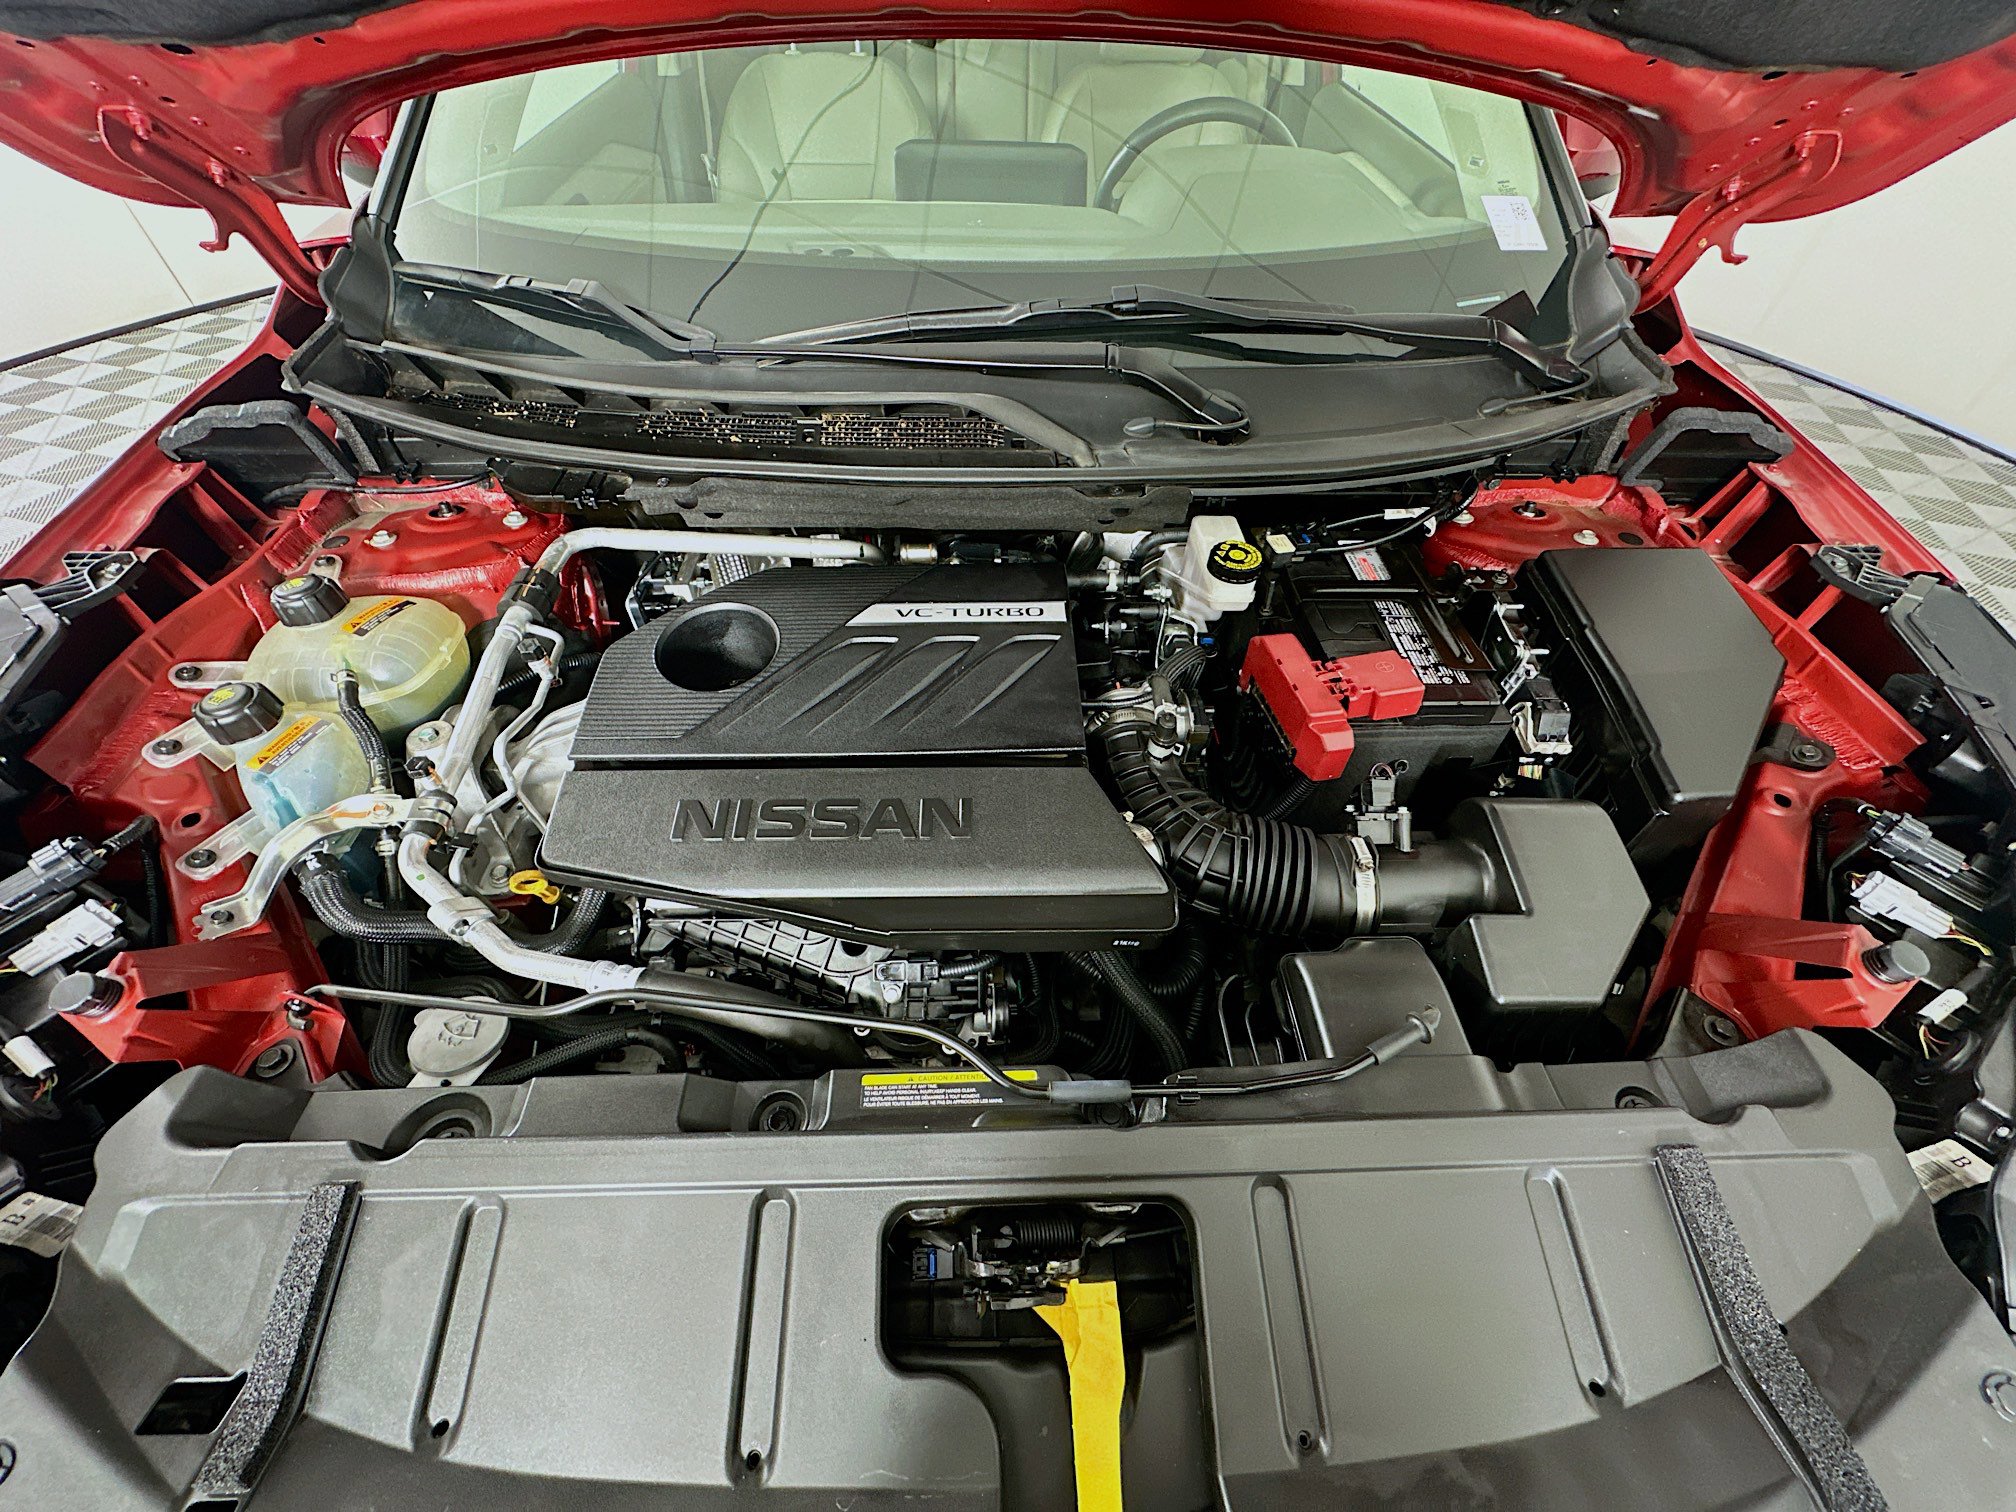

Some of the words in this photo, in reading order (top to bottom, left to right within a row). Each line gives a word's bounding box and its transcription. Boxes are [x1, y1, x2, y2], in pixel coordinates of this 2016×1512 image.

[895, 606, 1044, 618] VC-TURBO
[266, 731, 292, 753] WARNING
[670, 798, 973, 842] NISSAN
[918, 1074, 948, 1082] CAUTION
